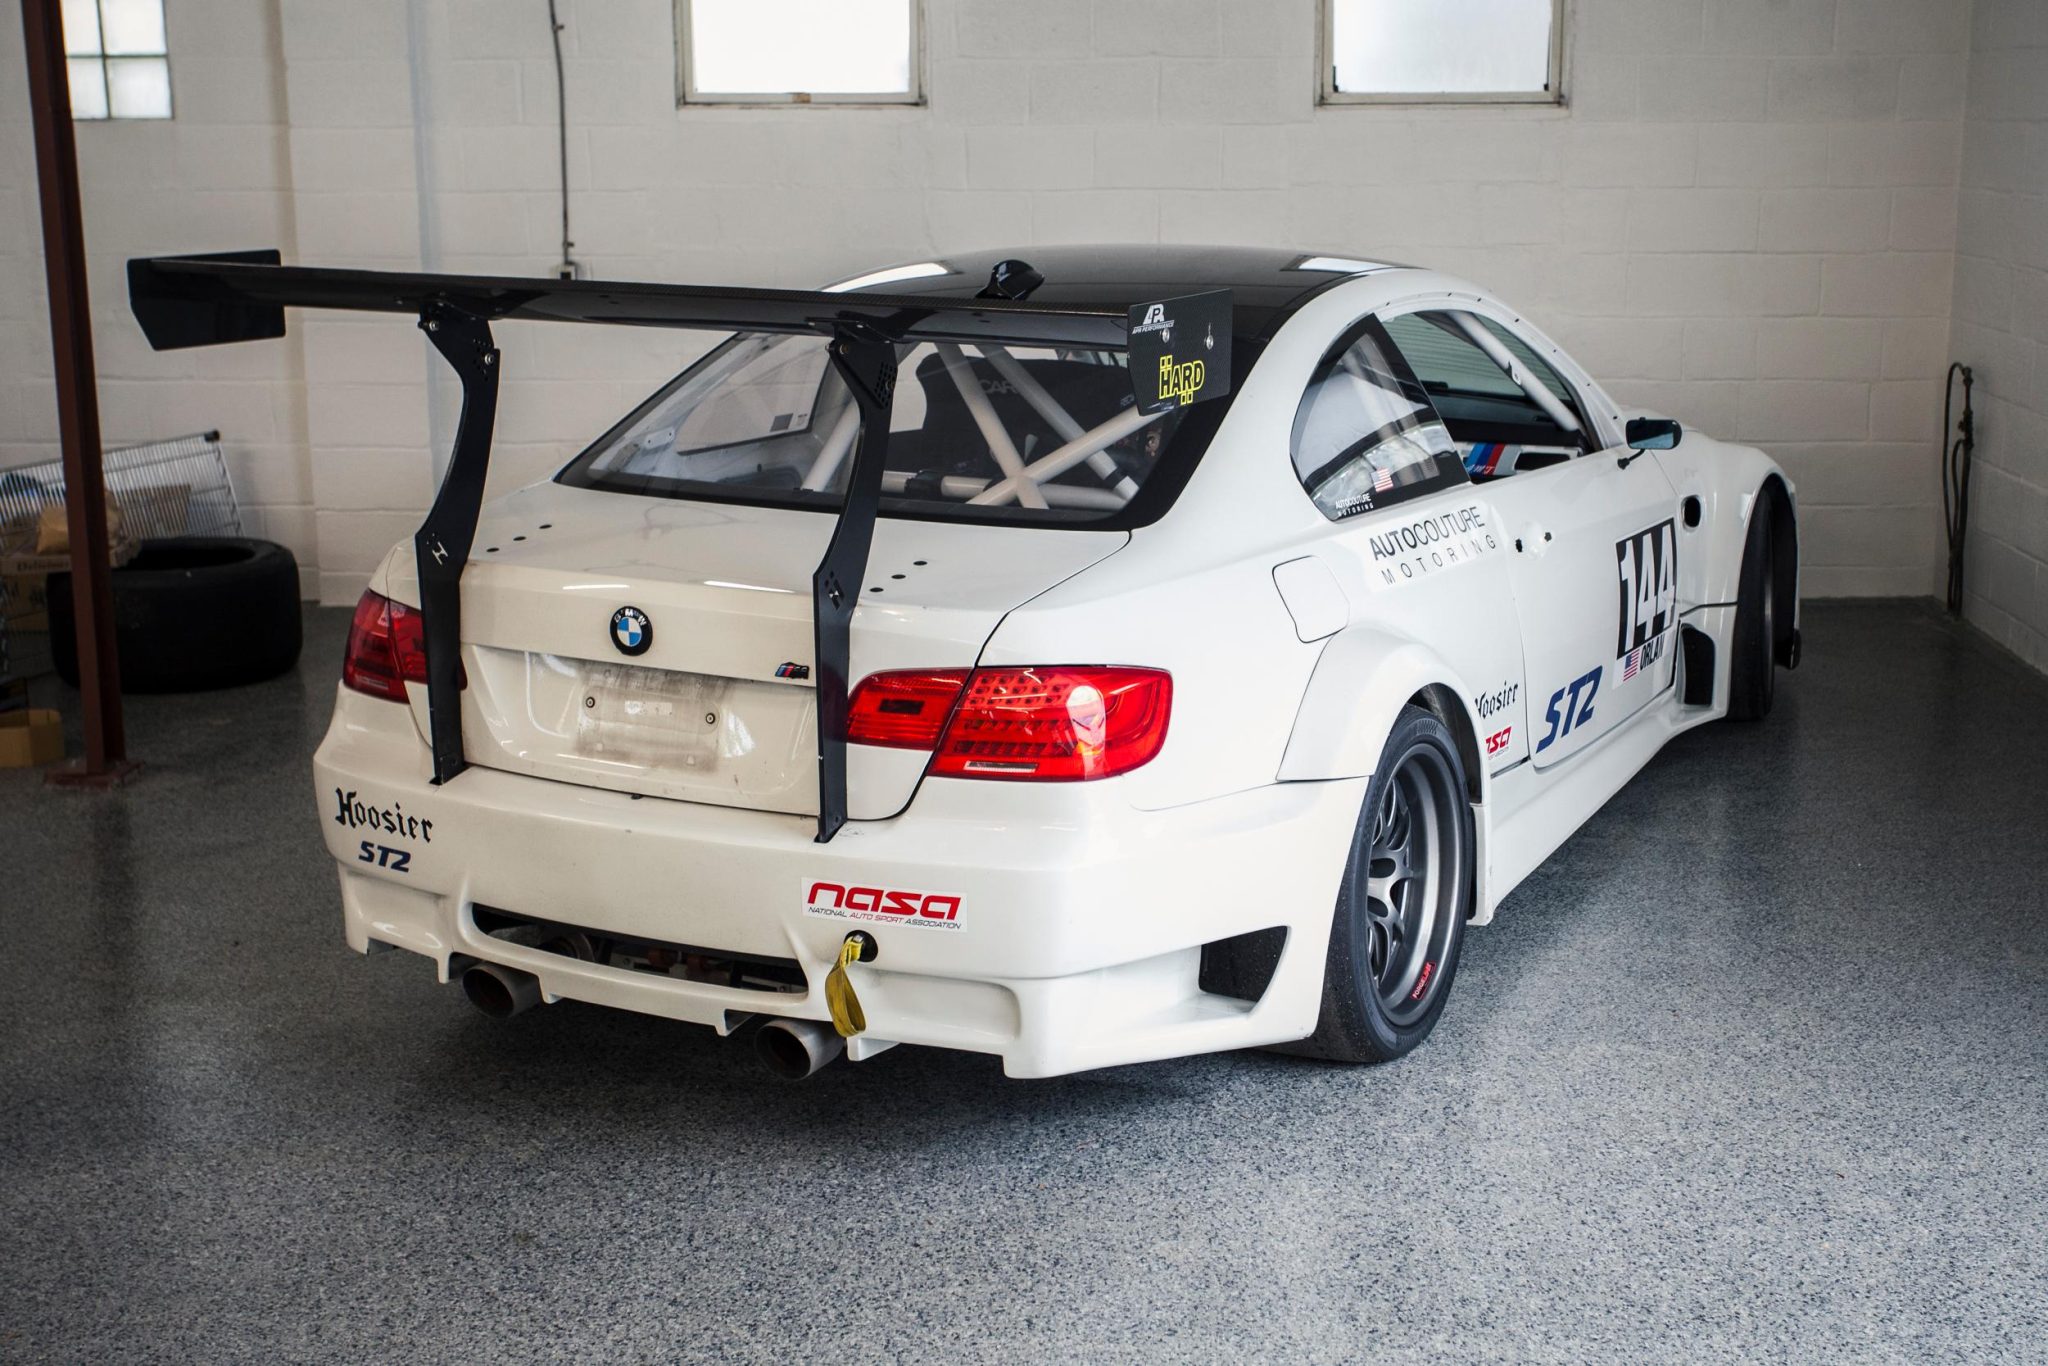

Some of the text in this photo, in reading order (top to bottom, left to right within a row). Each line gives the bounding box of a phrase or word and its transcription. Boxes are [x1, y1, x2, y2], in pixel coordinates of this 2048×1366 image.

[1335, 492, 1372, 509] AUTOCOUTURE
[1337, 502, 1375, 518] MOTORING
[1368, 506, 1486, 561] AUTOCOUTURE
[1381, 534, 1497, 586] MOTORING
[1620, 523, 1676, 653] 144
[613, 607, 647, 626] BMW
[1535, 665, 1604, 754] ST2
[335, 787, 433, 843] Hoosier
[357, 840, 412, 873] ST2
[807, 881, 962, 922] nasa
[808, 907, 961, 930] NATIONAL AUTO SPORT ASSOCIATION
